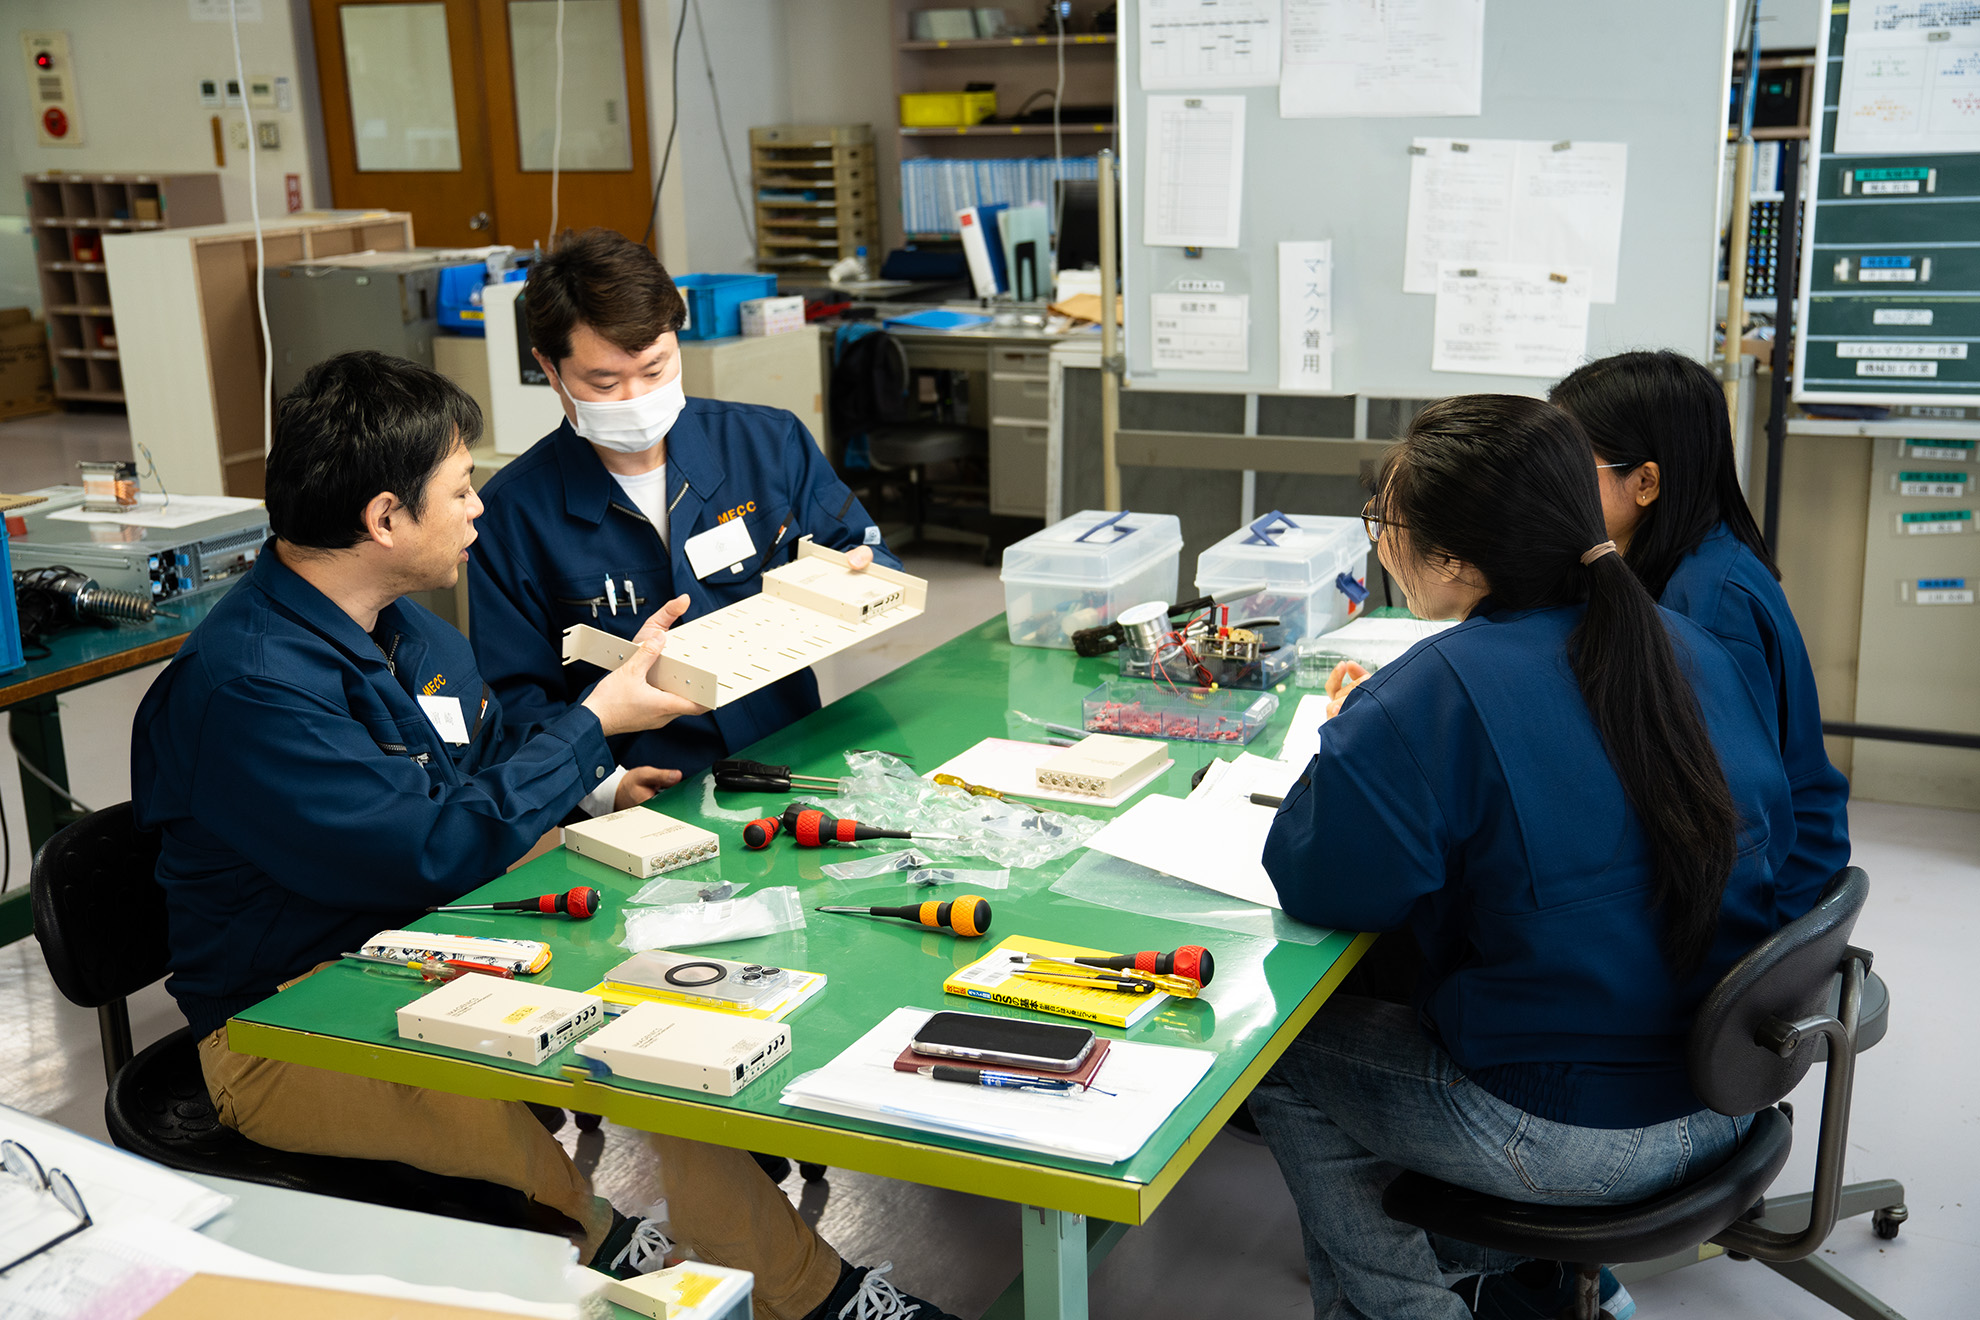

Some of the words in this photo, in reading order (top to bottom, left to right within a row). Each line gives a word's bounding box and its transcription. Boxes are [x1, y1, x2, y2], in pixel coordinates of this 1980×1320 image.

[1302, 257, 1324, 374] マスク着用
[717, 501, 757, 525] MECC
[422, 673, 447, 696] MECC
